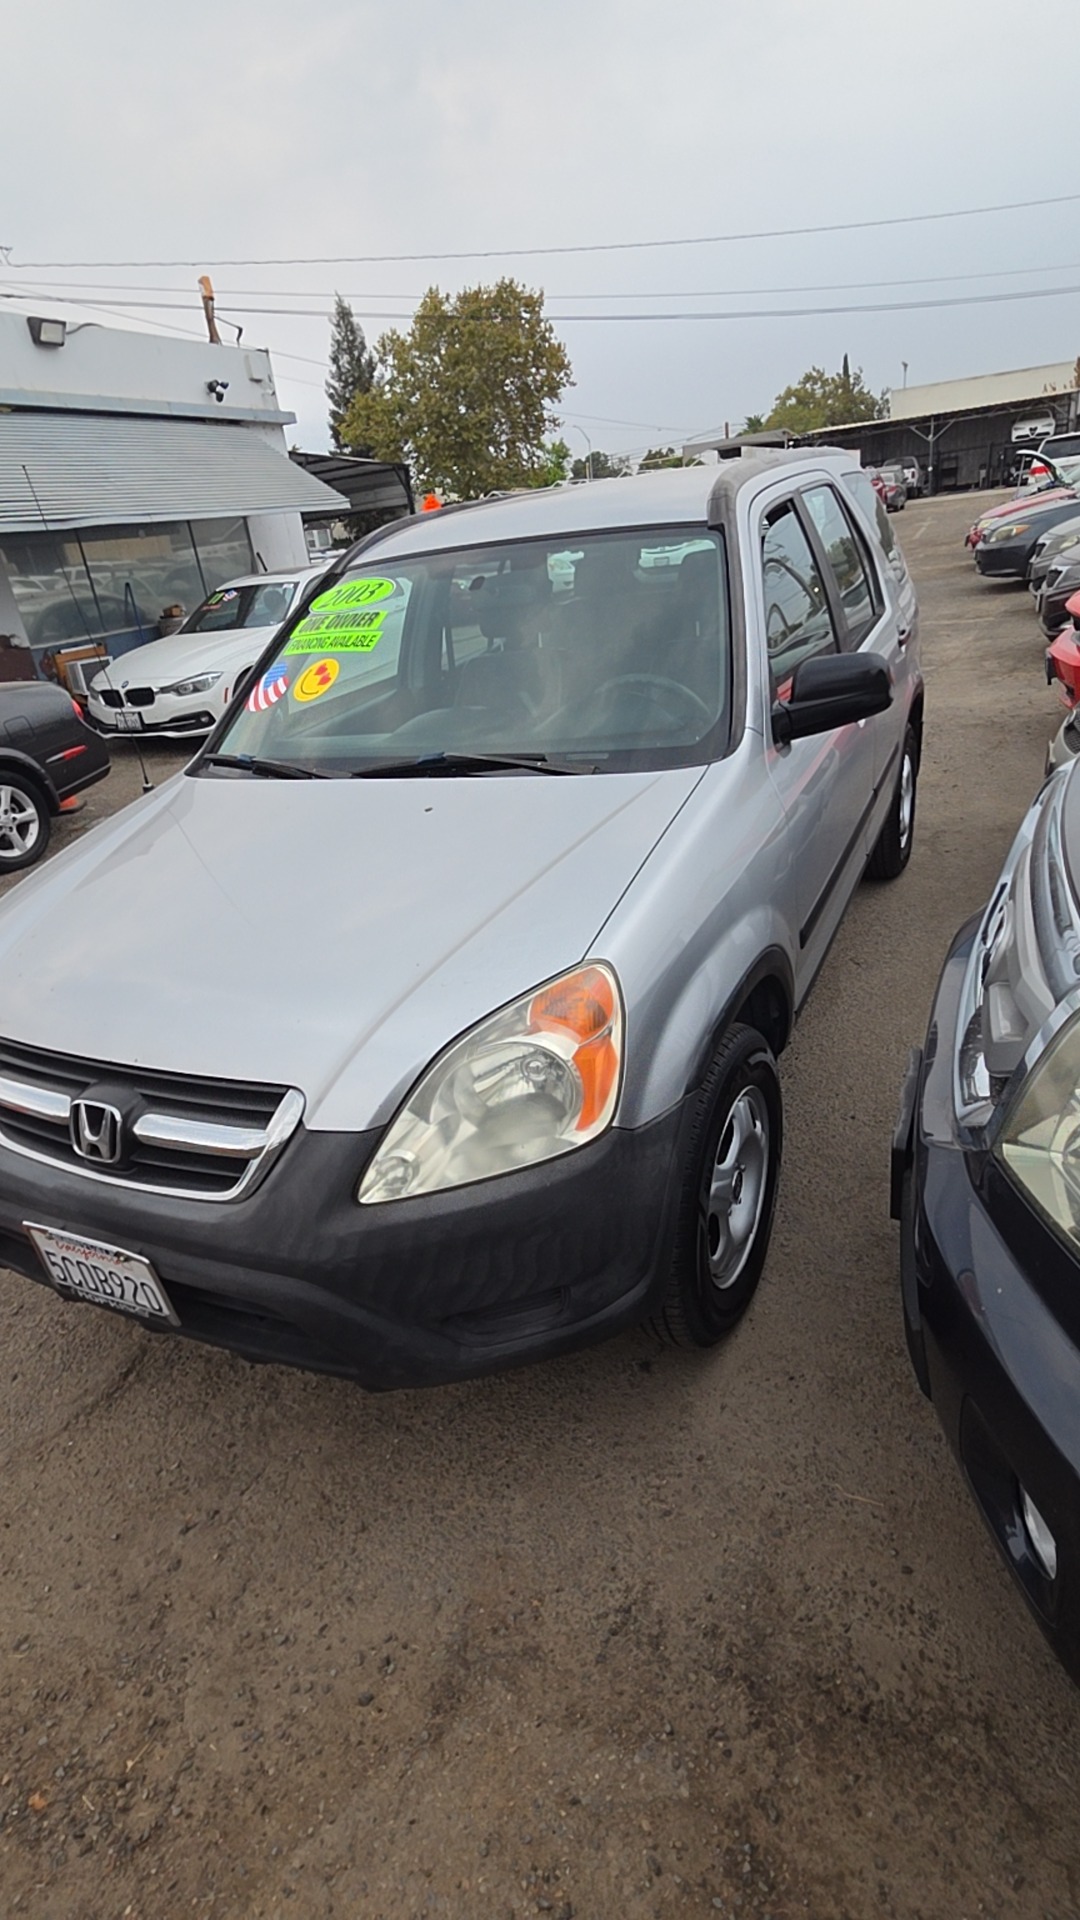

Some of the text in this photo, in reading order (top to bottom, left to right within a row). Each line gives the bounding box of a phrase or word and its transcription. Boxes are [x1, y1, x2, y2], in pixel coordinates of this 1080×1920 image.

[318, 581, 385, 609] 2003
[299, 612, 380, 633] ONE OWNER
[288, 634, 376, 651] FINANCING AVAILABLE
